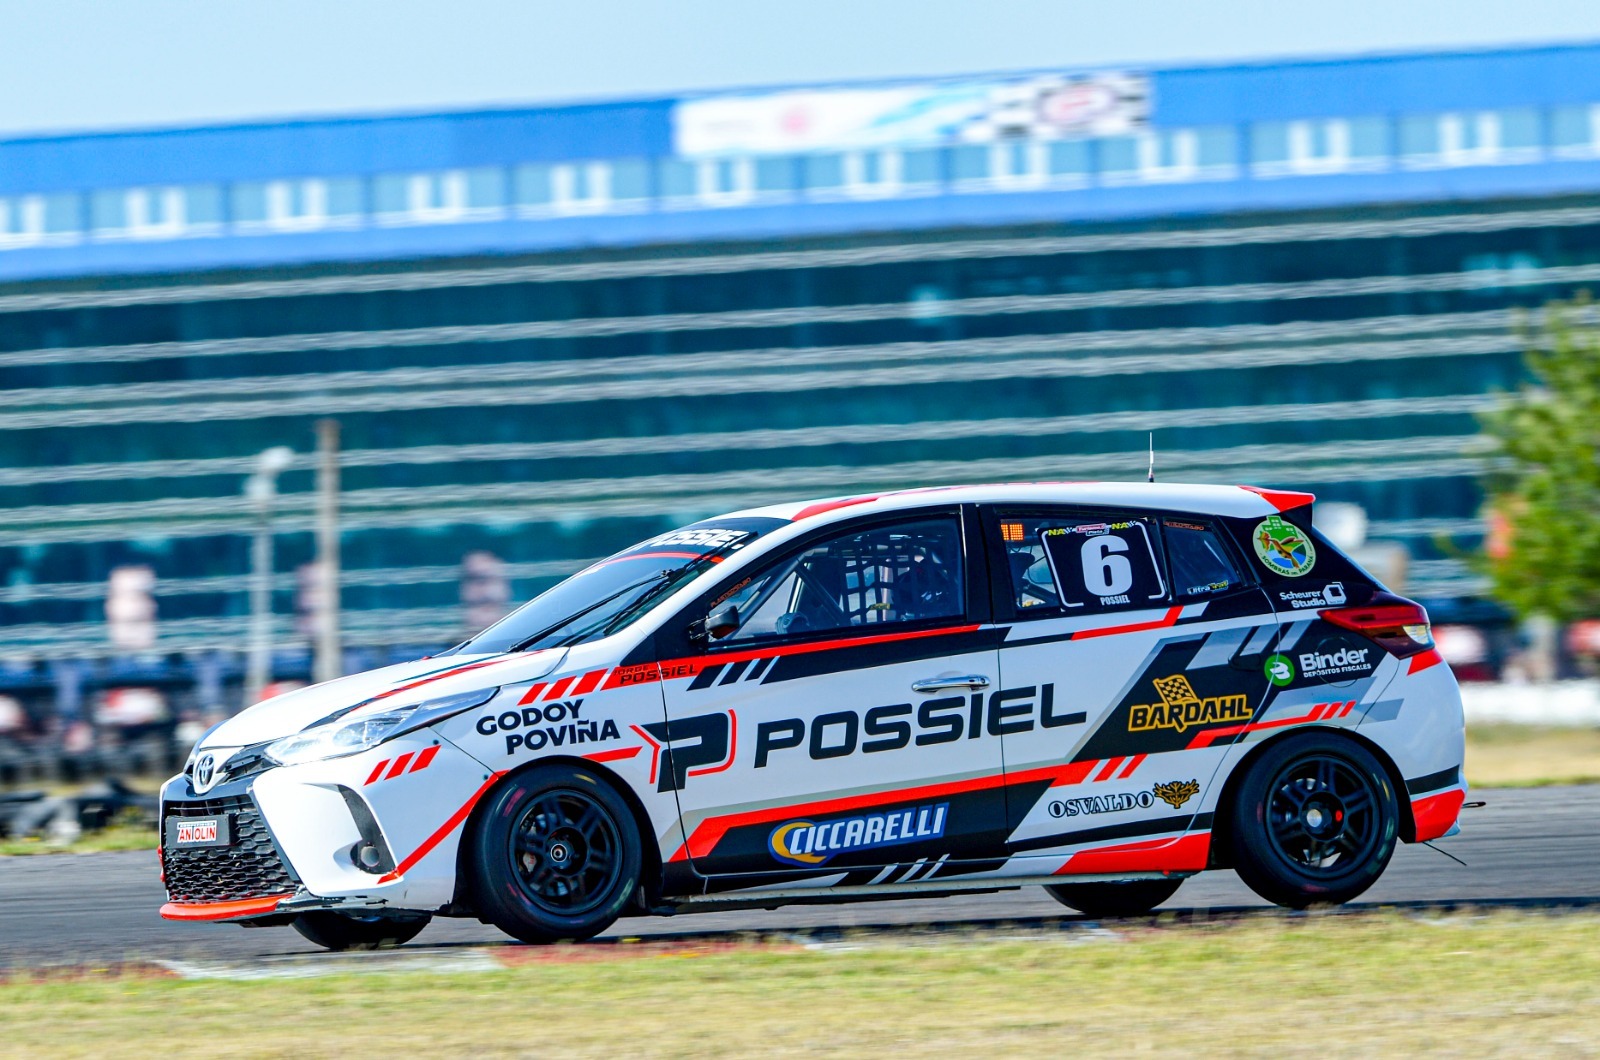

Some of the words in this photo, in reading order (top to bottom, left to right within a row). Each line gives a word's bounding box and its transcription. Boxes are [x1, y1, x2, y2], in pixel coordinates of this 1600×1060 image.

[1080, 534, 1133, 597] 6
[1261, 555, 1290, 575] SOMBRAS
[1100, 594, 1131, 607] POSSIEL
[1279, 590, 1321, 601] Scheurer
[1291, 597, 1326, 609] Studio
[1299, 648, 1369, 672] Binder
[620, 664, 698, 685] POSSIEL
[476, 699, 585, 736] GODOY
[754, 683, 1088, 769] POSSIEL
[1128, 694, 1254, 733] BARDAHL
[505, 719, 621, 755] POVIÑA
[1048, 791, 1155, 818] OSVALDO
[788, 806, 946, 856] CICCARELLI
